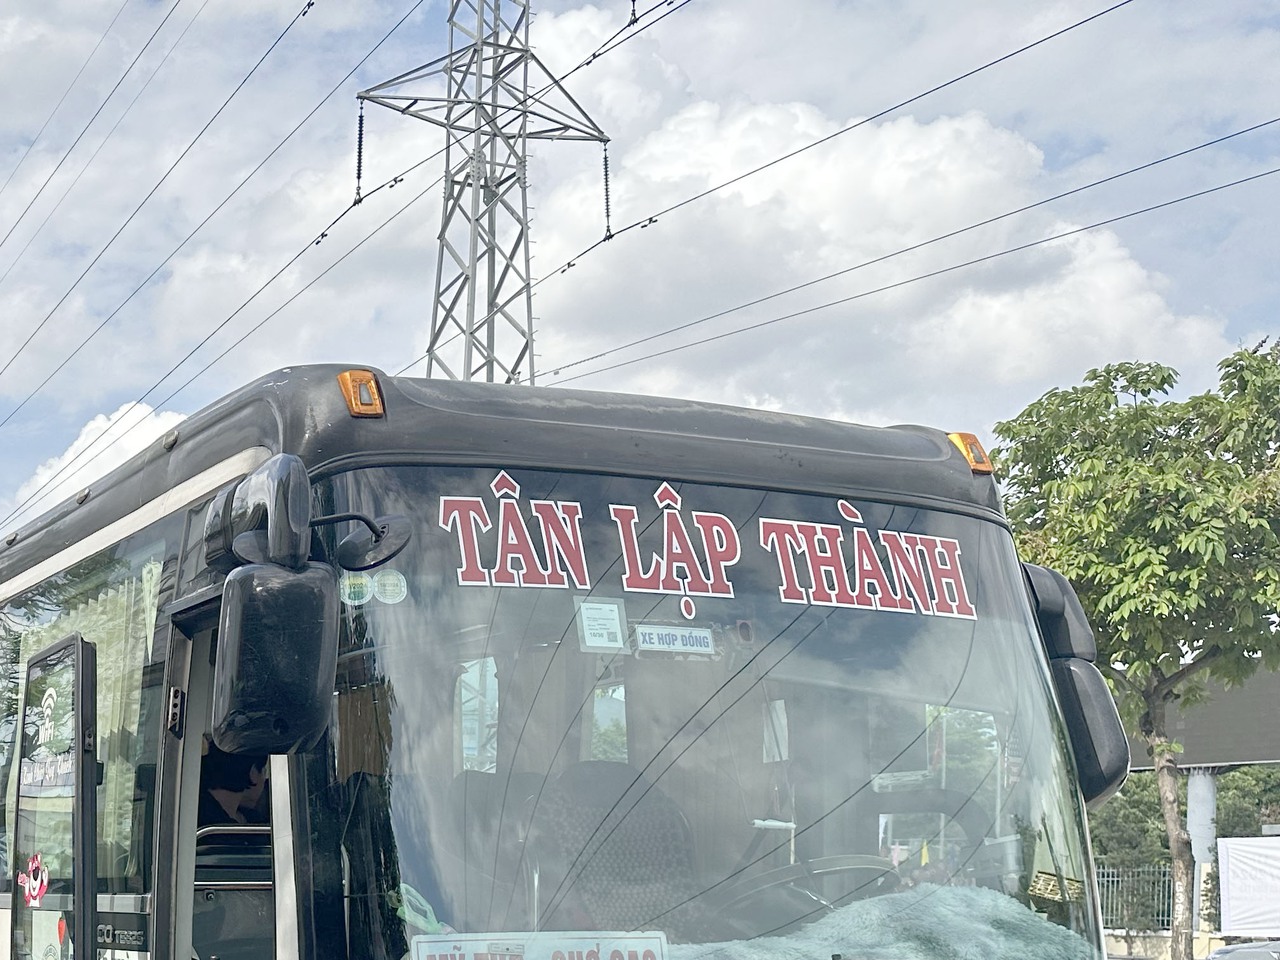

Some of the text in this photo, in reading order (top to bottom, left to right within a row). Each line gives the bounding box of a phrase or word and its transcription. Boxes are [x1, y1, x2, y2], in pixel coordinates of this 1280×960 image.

[439, 470, 977, 621] TÂN LẬP THÀNH
[640, 632, 655, 645] XE
[657, 632, 678, 649] HỢP
